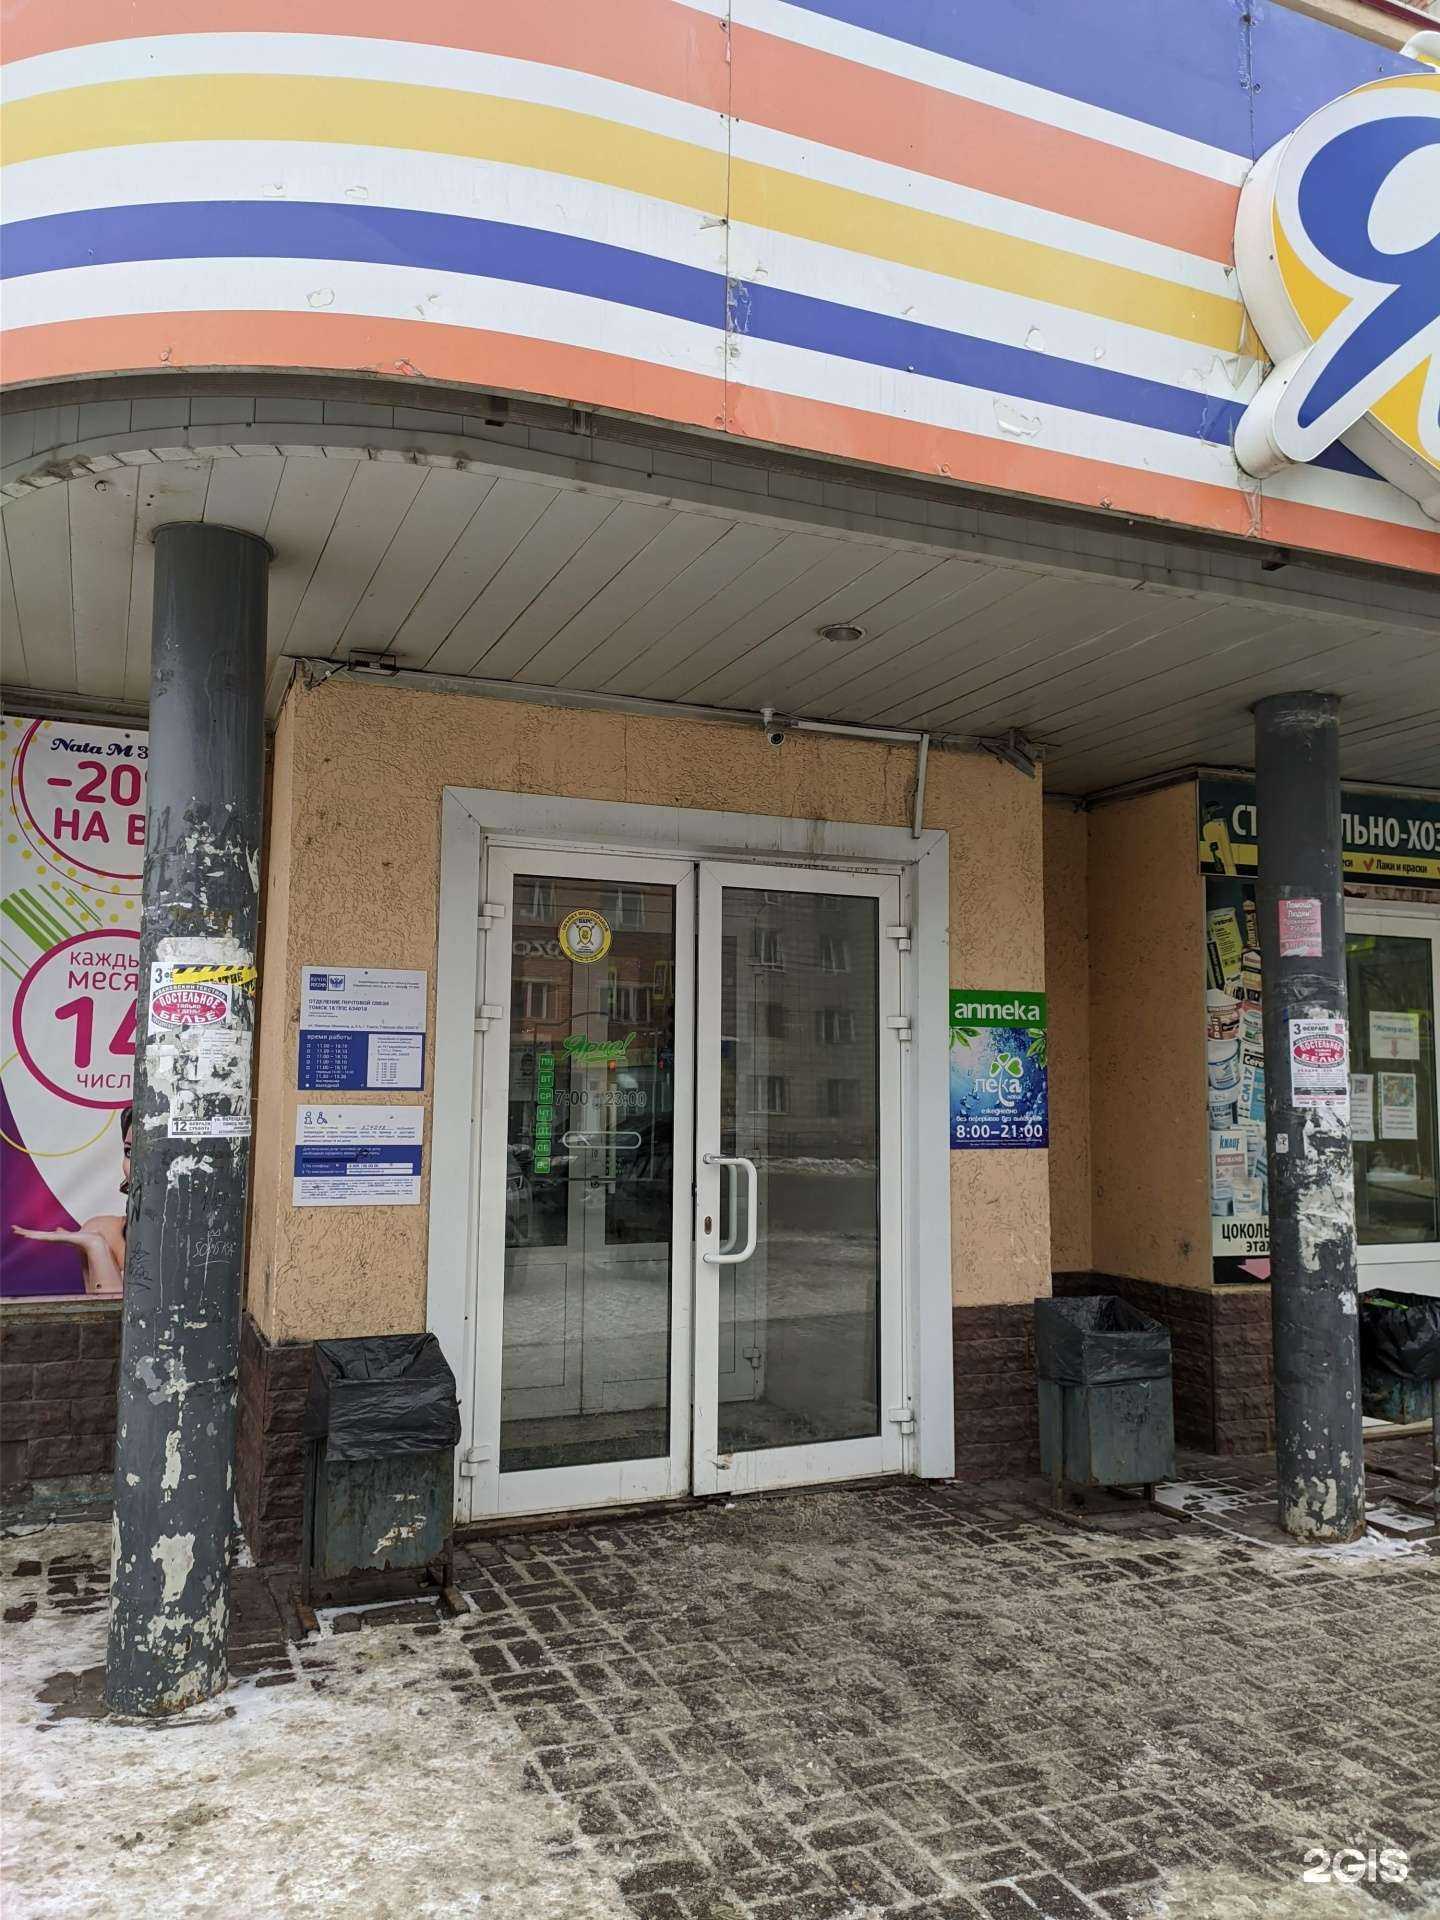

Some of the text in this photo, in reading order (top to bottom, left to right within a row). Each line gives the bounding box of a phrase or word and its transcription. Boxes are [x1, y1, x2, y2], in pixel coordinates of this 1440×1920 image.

[50, 738, 103, 755] Nata
[106, 743, 134, 757] M
[47, 760, 148, 806] -20
[53, 807, 146, 845] НА В
[1376, 859, 1395, 871] Лаки
[1402, 864, 1428, 874] краски
[68, 970, 139, 991] меся
[154, 967, 163, 984] 3
[159, 992, 221, 1009] ПОСТЕЛЬНОЕ
[159, 1010, 218, 1023] БЕЛЬЁ
[954, 1000, 1040, 1021] аптека
[1293, 1023, 1301, 1035] 3
[1244, 1056, 1265, 1068] Cere
[77, 1074, 131, 1089] числ
[555, 1090, 647, 1106] 7:00 23:00
[174, 1121, 187, 1132] 12
